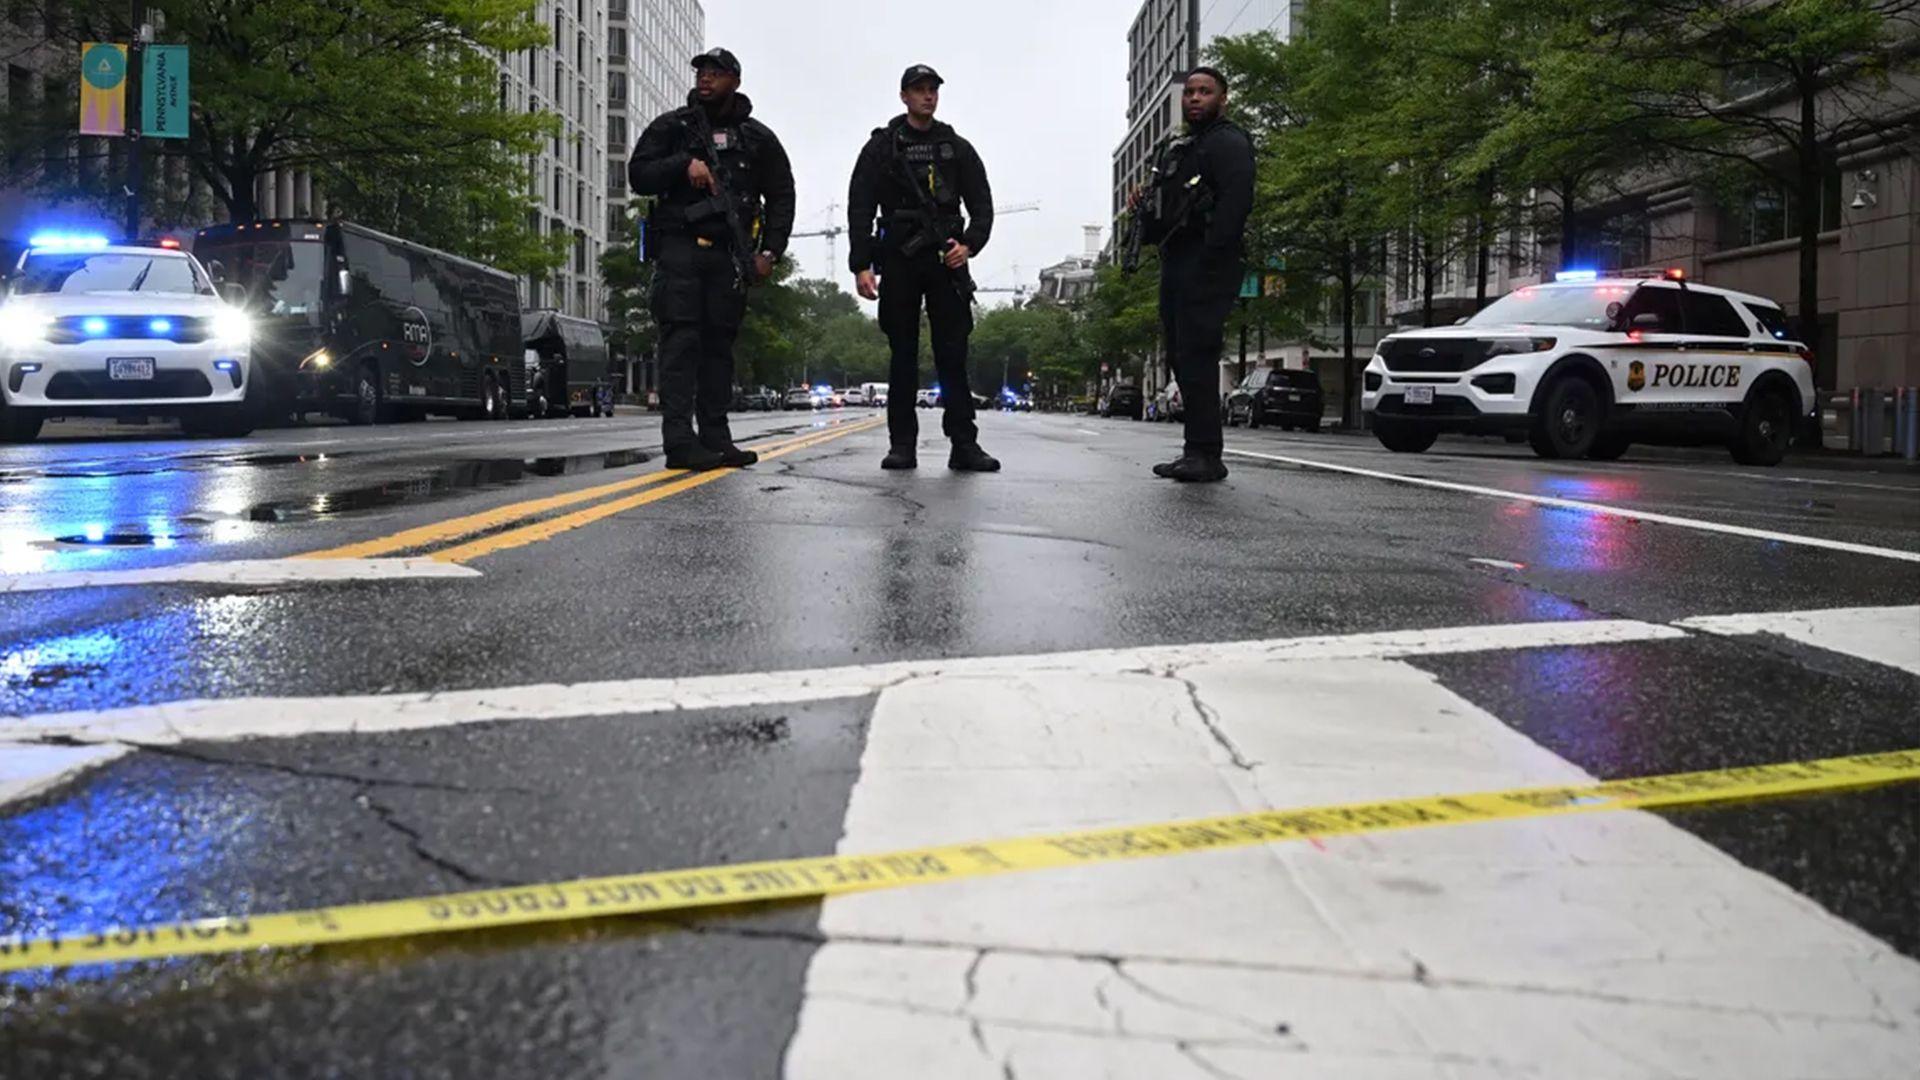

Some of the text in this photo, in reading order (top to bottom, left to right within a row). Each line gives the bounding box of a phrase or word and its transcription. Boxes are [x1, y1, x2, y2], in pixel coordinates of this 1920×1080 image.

[155, 51, 167, 132] PENNSYLVANIA
[169, 75, 177, 108] AVENUE
[1651, 364, 1741, 387] POLICE
